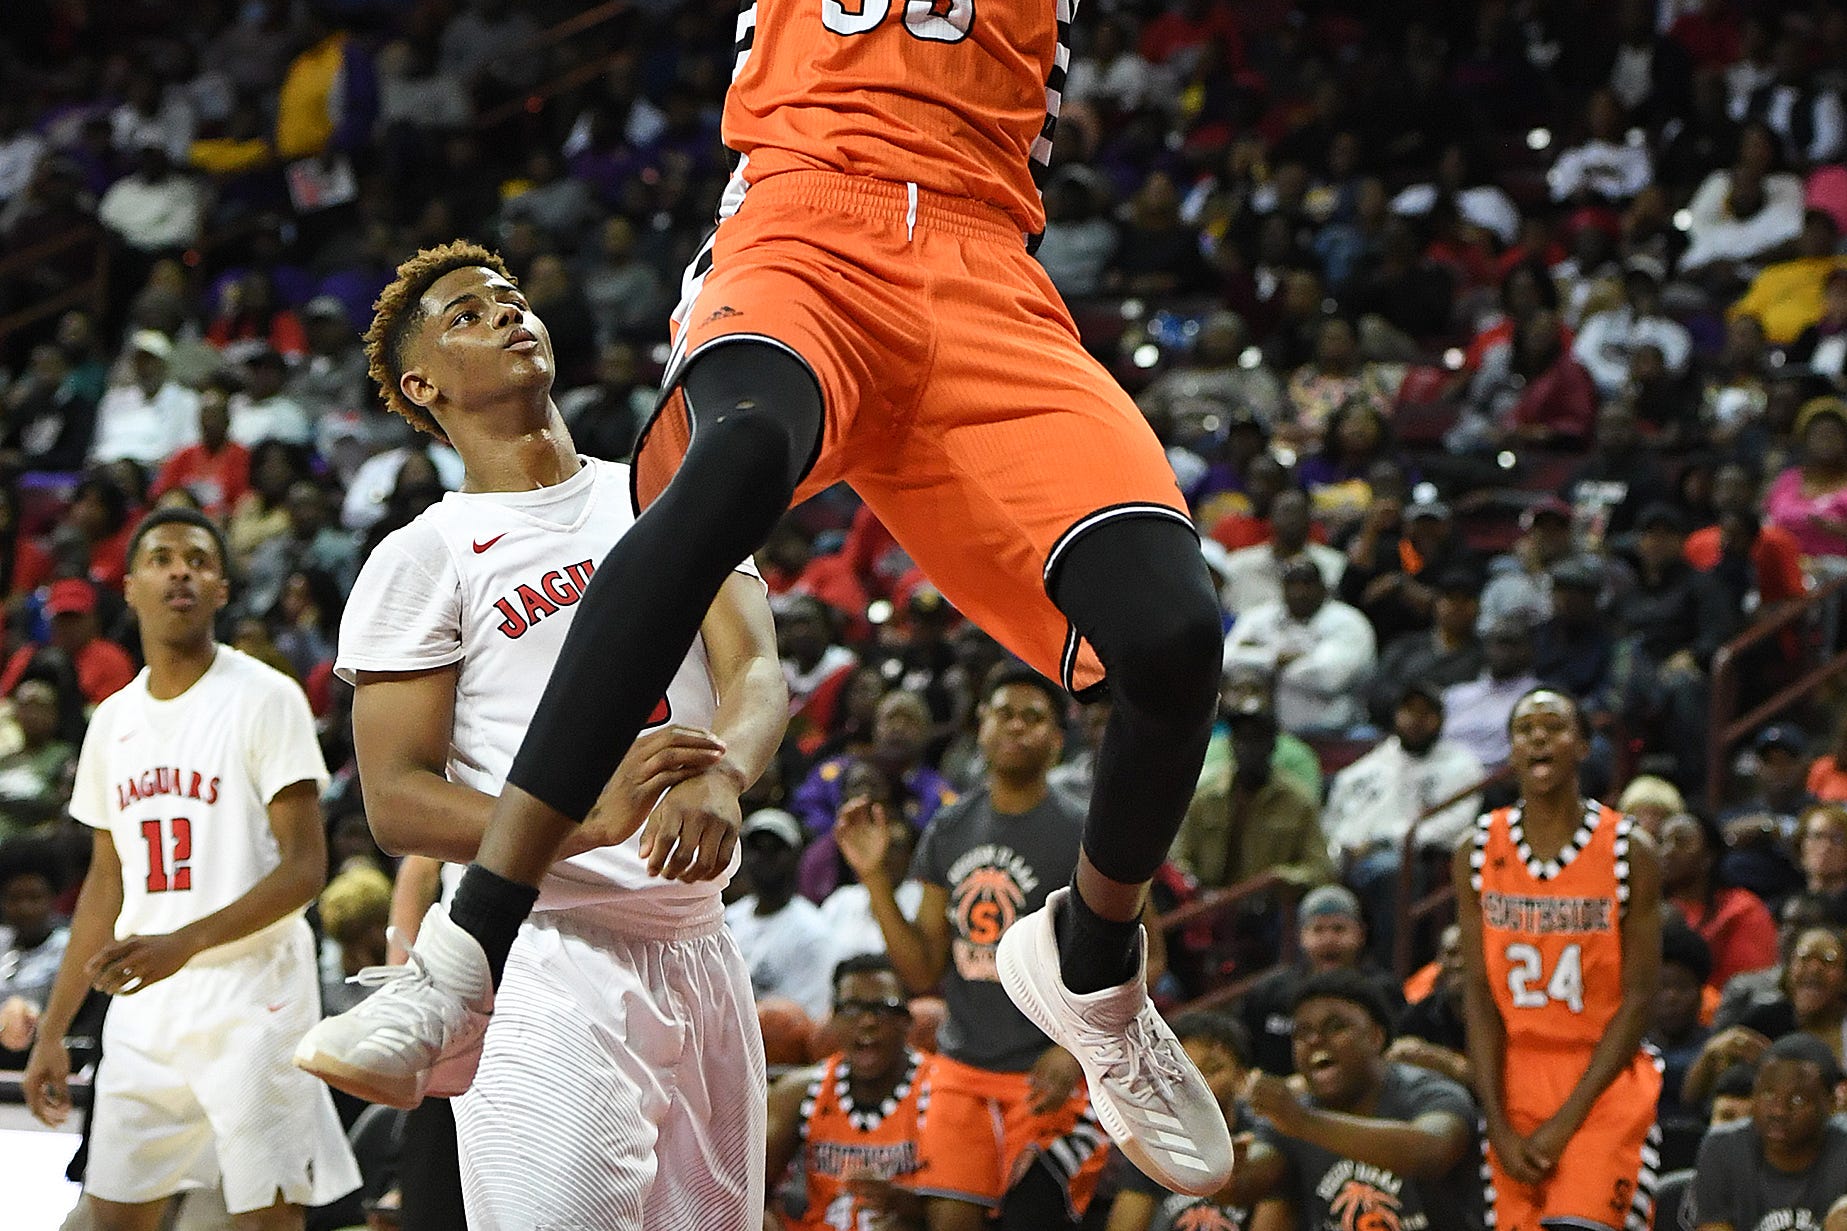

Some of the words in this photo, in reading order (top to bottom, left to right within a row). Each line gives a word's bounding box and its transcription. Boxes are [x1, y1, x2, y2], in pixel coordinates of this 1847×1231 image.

[117, 766, 221, 811] JAGUARS
[140, 817, 192, 893] 12
[1505, 942, 1585, 1014] 24
